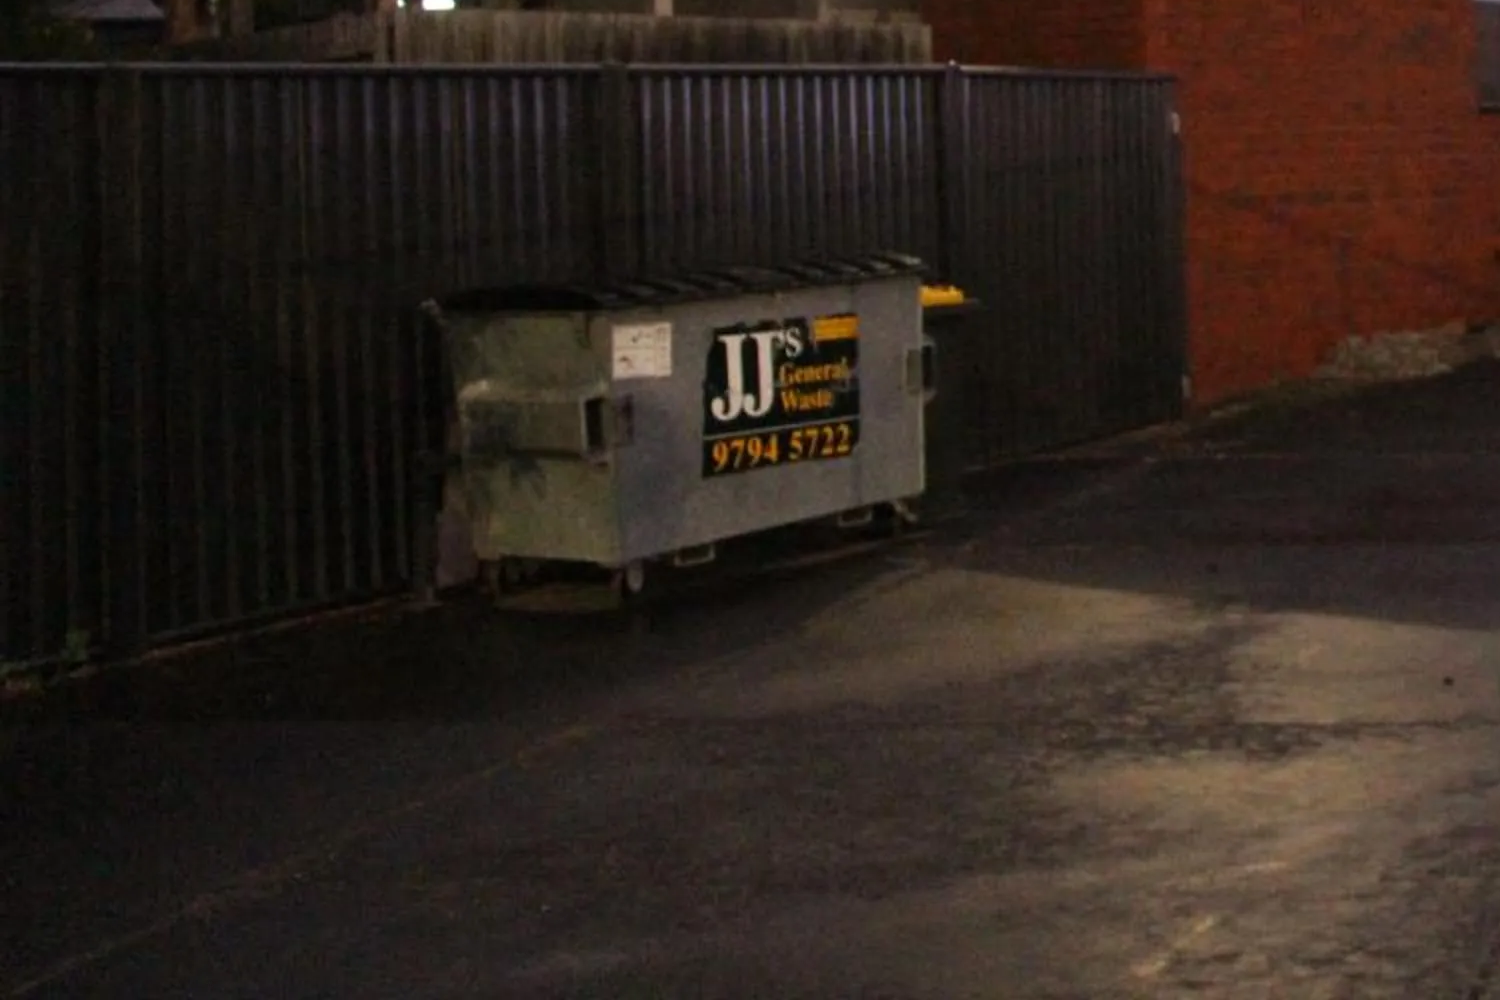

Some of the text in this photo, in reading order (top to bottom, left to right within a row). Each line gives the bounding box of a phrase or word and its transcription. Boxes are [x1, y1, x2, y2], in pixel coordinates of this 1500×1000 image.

[779, 358, 849, 386] General
[781, 388, 834, 414] Waste
[712, 424, 851, 473] 9794 5722
